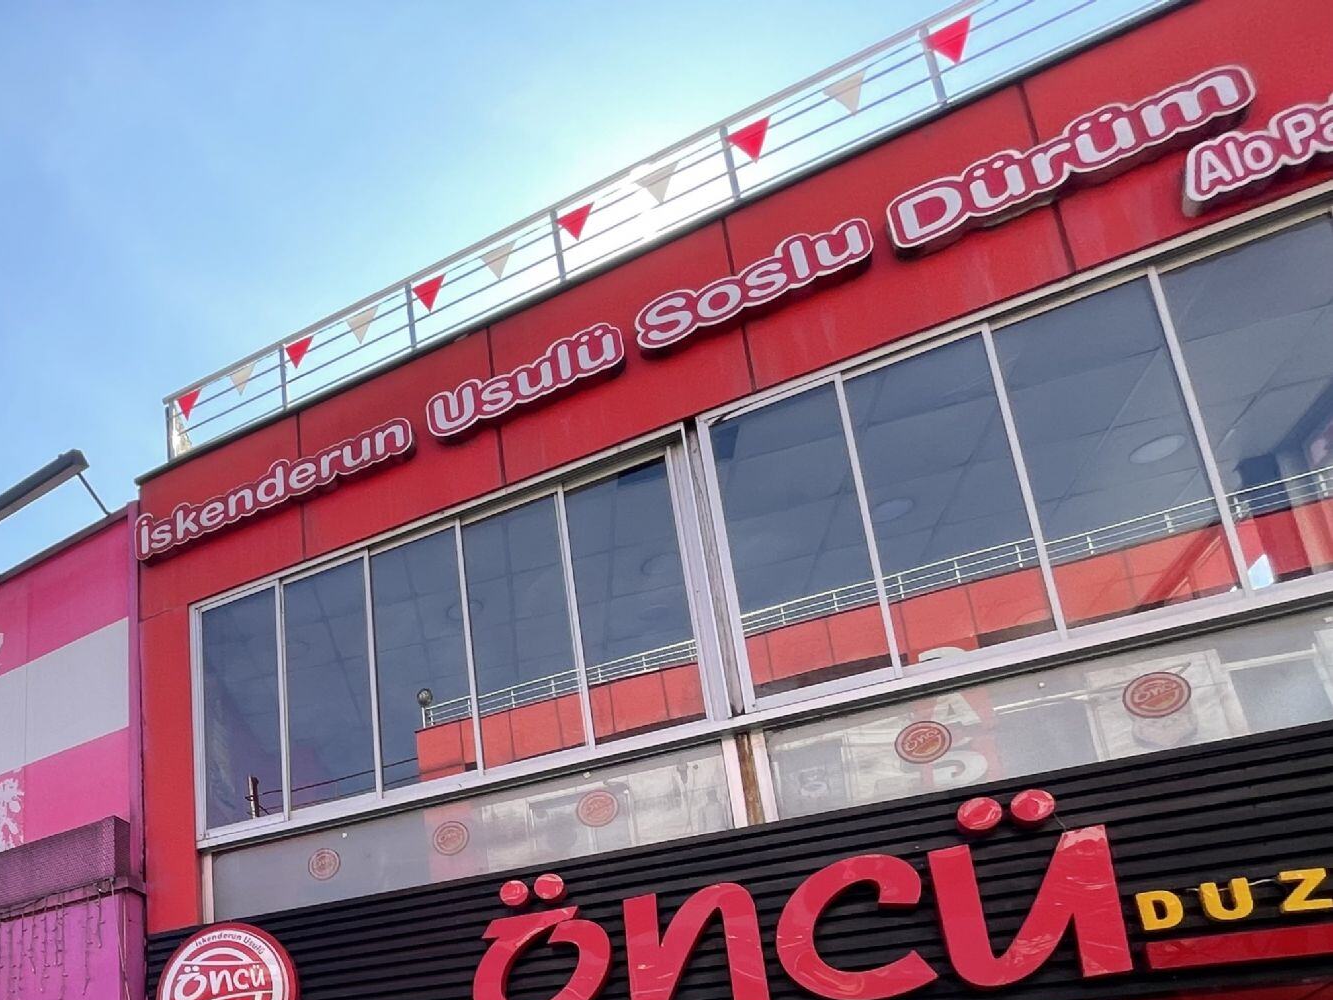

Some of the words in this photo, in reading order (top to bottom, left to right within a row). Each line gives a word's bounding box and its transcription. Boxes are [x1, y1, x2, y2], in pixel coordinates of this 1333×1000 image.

[1198, 136, 1274, 192] Alo
[137, 421, 408, 555] İskenderun
[431, 333, 616, 434] Usulü
[642, 224, 866, 342] Soslu
[894, 73, 1244, 241] Dürüm
